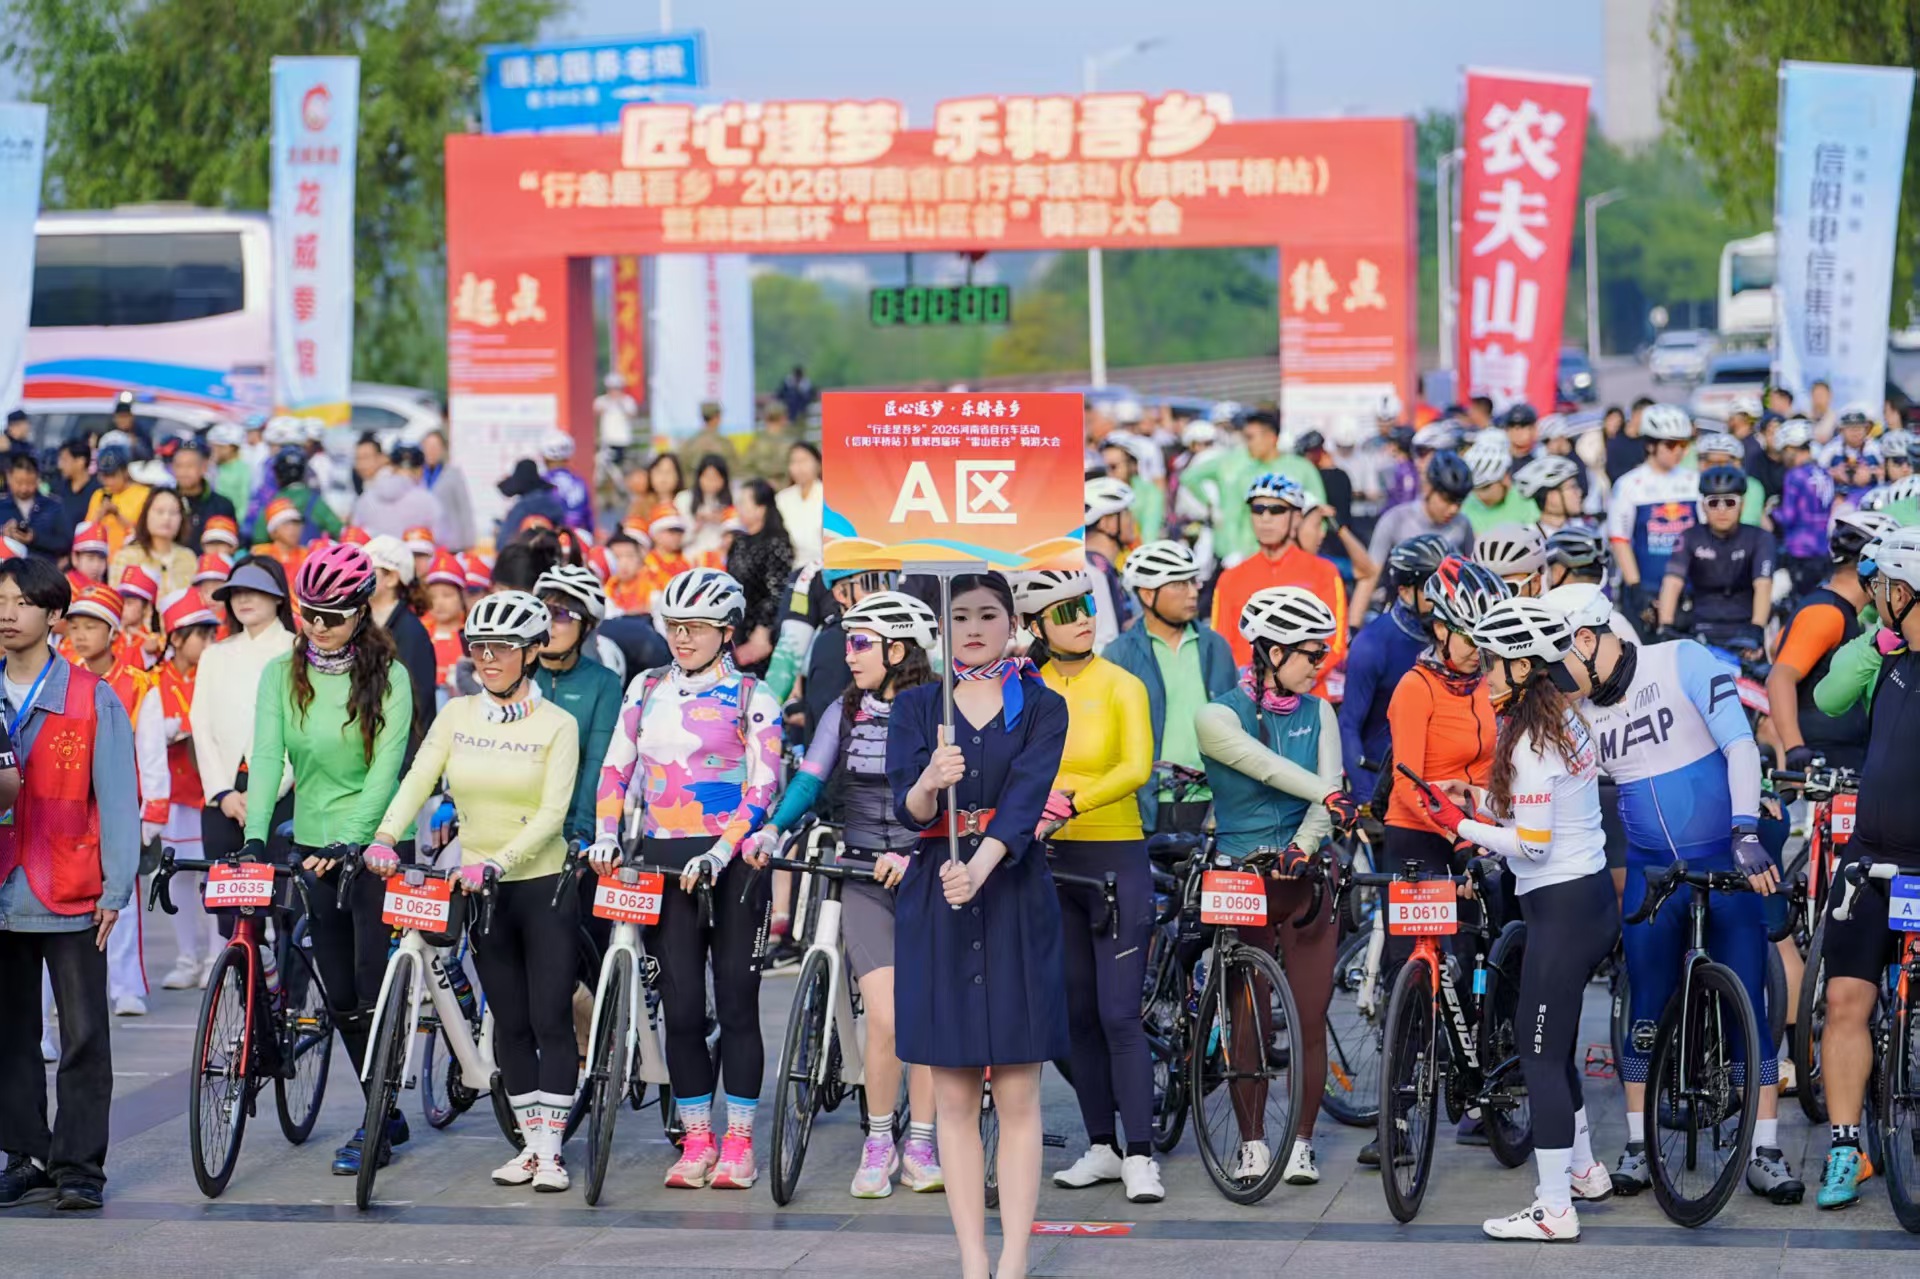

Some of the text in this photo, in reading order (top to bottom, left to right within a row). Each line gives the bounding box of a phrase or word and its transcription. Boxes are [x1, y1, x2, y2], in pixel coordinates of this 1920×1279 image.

[623, 92, 1224, 168] 匠心逐梦 乐骑吾乡
[888, 460, 1018, 524] A区
[1508, 642, 1534, 651] PMT
[453, 732, 545, 753] RADIANT
[1842, 817, 1850, 830] B
[216, 882, 265, 894] B 0635
[394, 897, 442, 917] B 0625
[605, 890, 655, 910] B 0623
[1213, 895, 1261, 911] B 0609
[1400, 905, 1449, 920] B 0610
[752, 927, 762, 957] Explore
[1439, 963, 1480, 1068] MERIDA
[1534, 1004, 1548, 1054] SCKER
